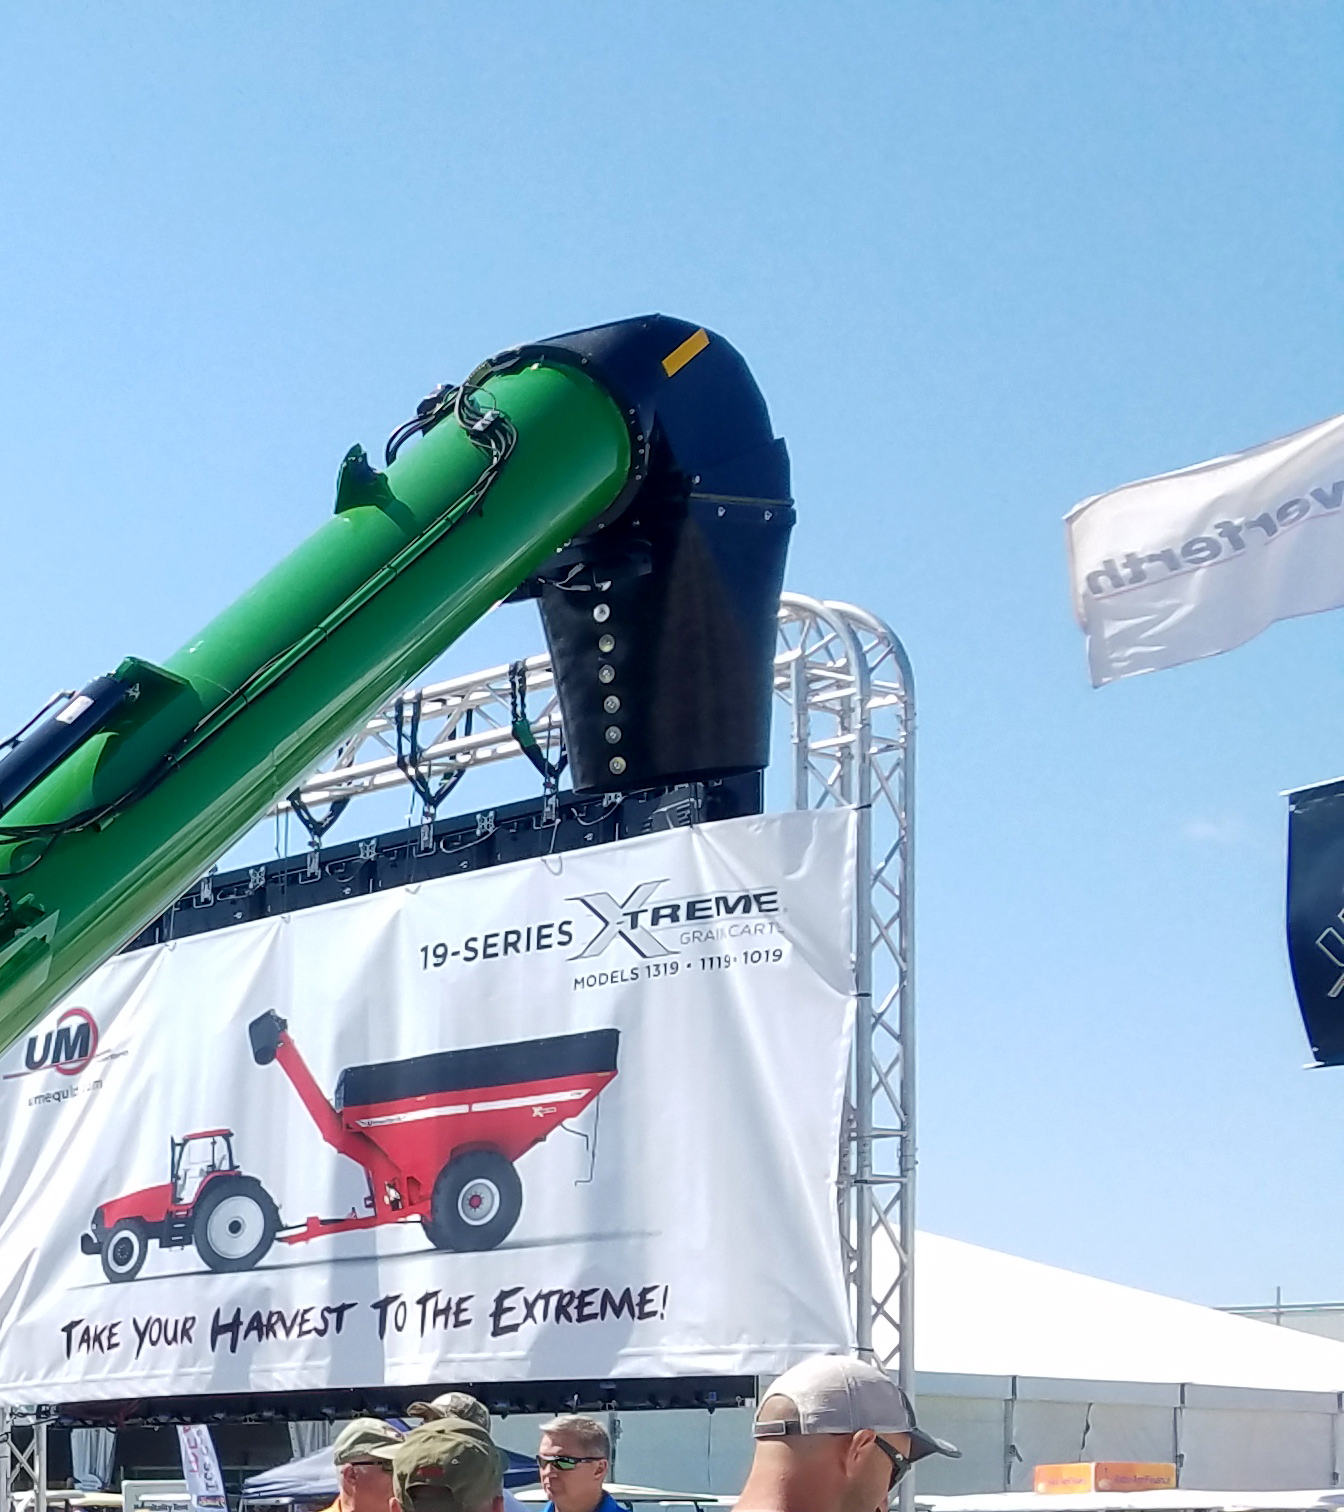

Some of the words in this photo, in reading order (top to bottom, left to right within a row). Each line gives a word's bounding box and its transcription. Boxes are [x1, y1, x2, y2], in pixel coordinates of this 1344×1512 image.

[419, 920, 574, 971] 19-SERIES
[573, 967, 640, 991] MODELS
[645, 961, 680, 980] 1319
[700, 954, 731, 972] 1119
[742, 948, 784, 964] 1019
[25, 1022, 91, 1070] UM
[61, 1318, 123, 1360] TAKE
[132, 1315, 197, 1360] YOUR
[211, 1302, 358, 1354] HARVEST
[370, 1293, 408, 1340] TO
[416, 1289, 476, 1338] THE
[489, 1284, 669, 1338] EXTREME!
